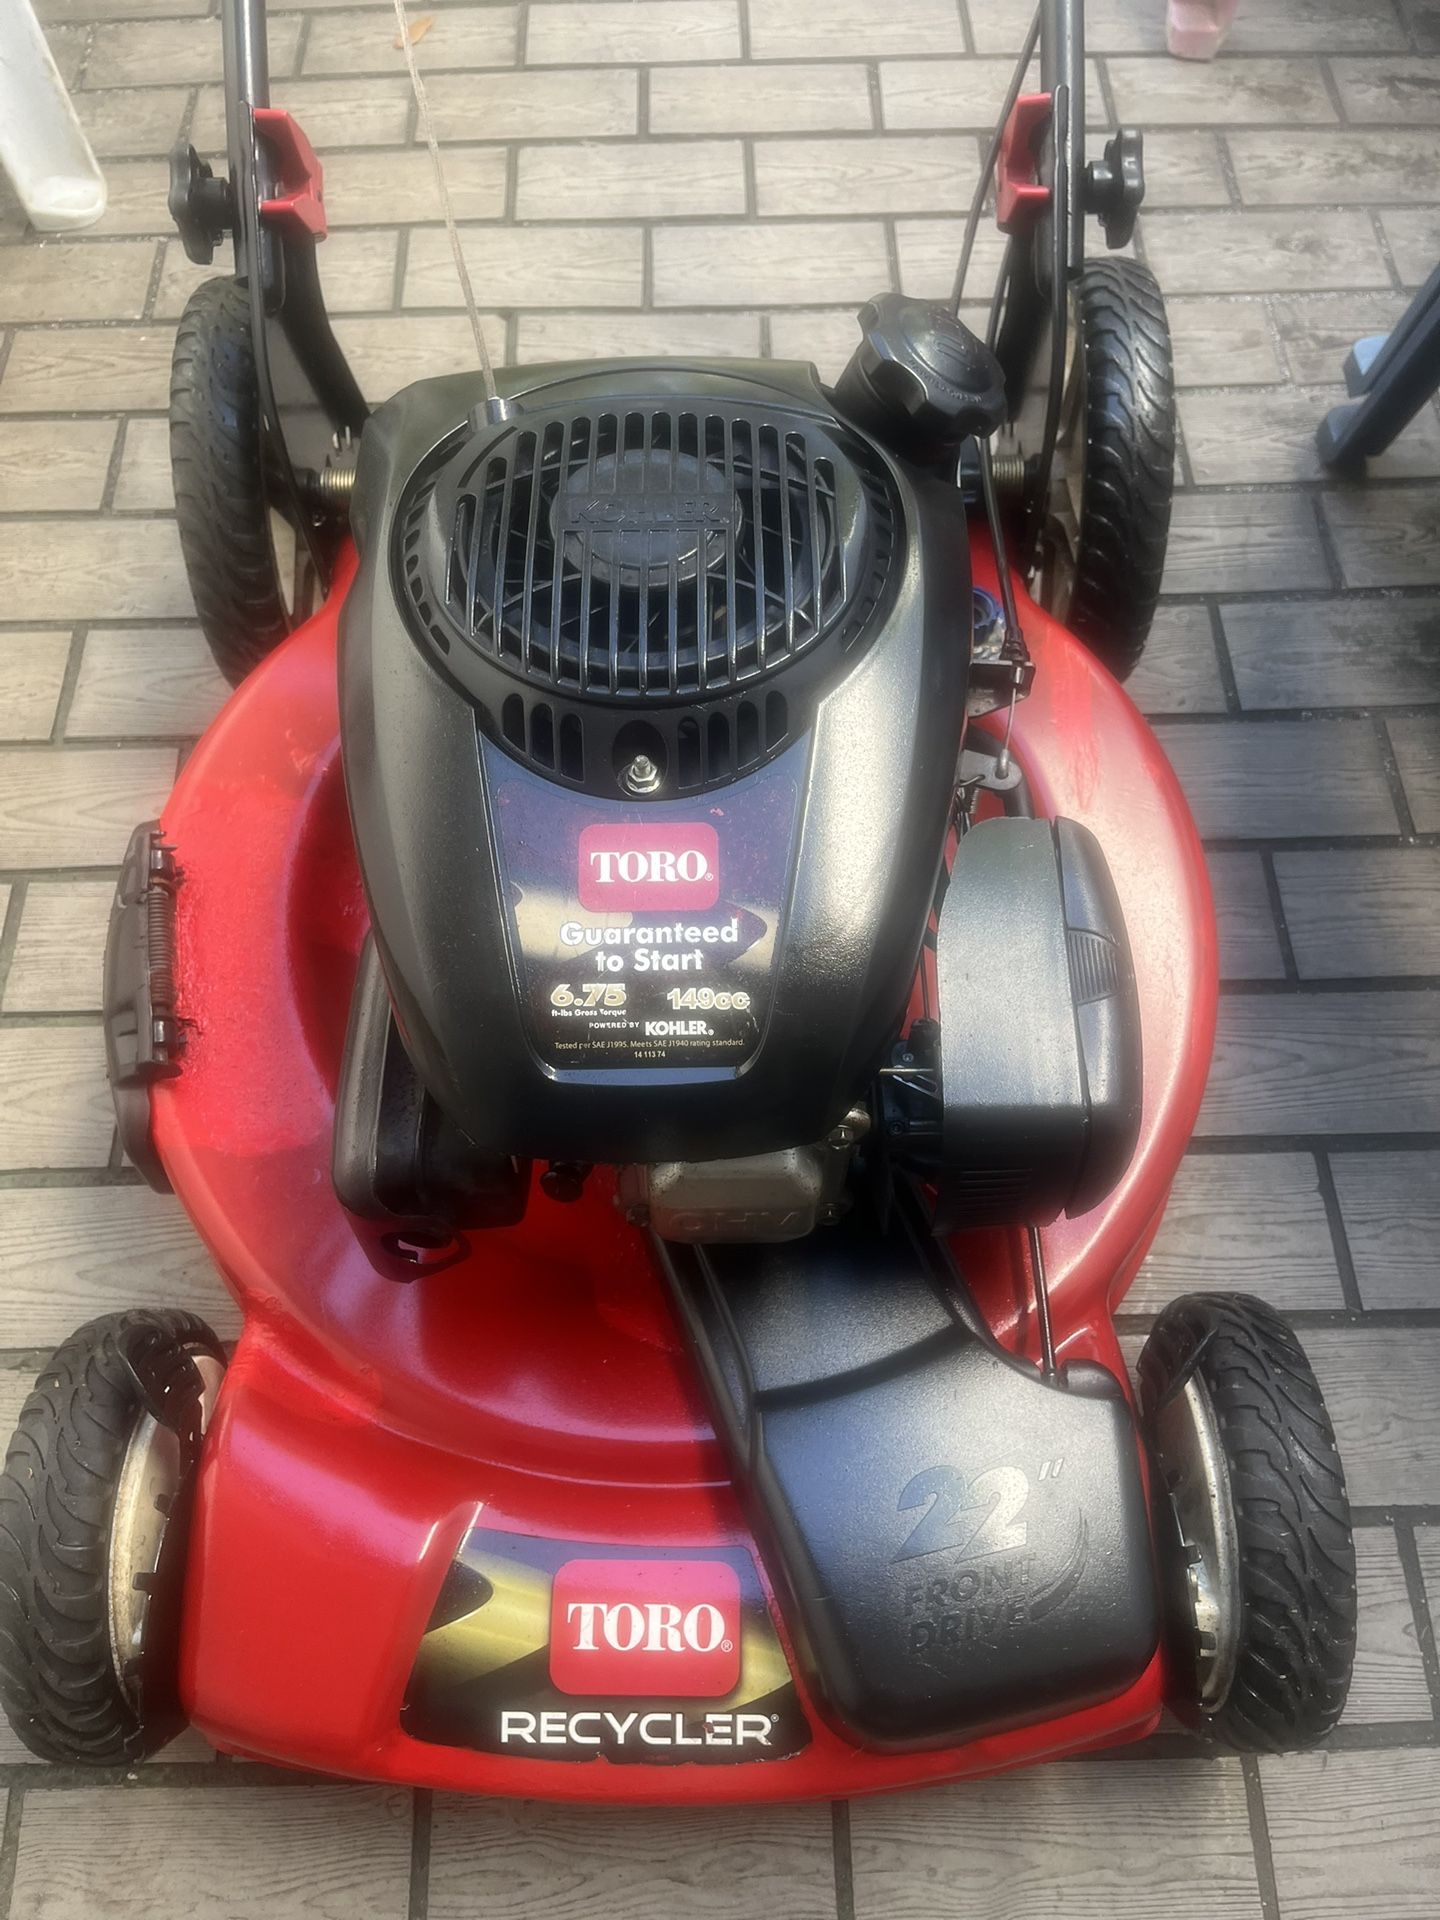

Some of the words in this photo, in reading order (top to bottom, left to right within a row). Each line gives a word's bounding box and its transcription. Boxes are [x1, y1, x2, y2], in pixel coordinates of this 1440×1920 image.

[560, 917, 739, 946] Guaranteed
[595, 951, 624, 972] to
[634, 948, 704, 972] Start
[550, 983, 627, 1007] 6.75
[666, 987, 751, 1010] 149cc
[551, 1009, 573, 1017] ft-lbs
[574, 1009, 598, 1017] Gross
[599, 1008, 627, 1018] Torque
[588, 1022, 627, 1030] POWERED
[629, 1021, 640, 1029] BY
[554, 1042, 578, 1050] Tested
[592, 1041, 605, 1049] SAE
[630, 1040, 652, 1048] Meets
[654, 1040, 667, 1048] SAE
[668, 1039, 689, 1048] J1940
[690, 1038, 712, 1049] rating
[712, 1038, 745, 1047] standard.
